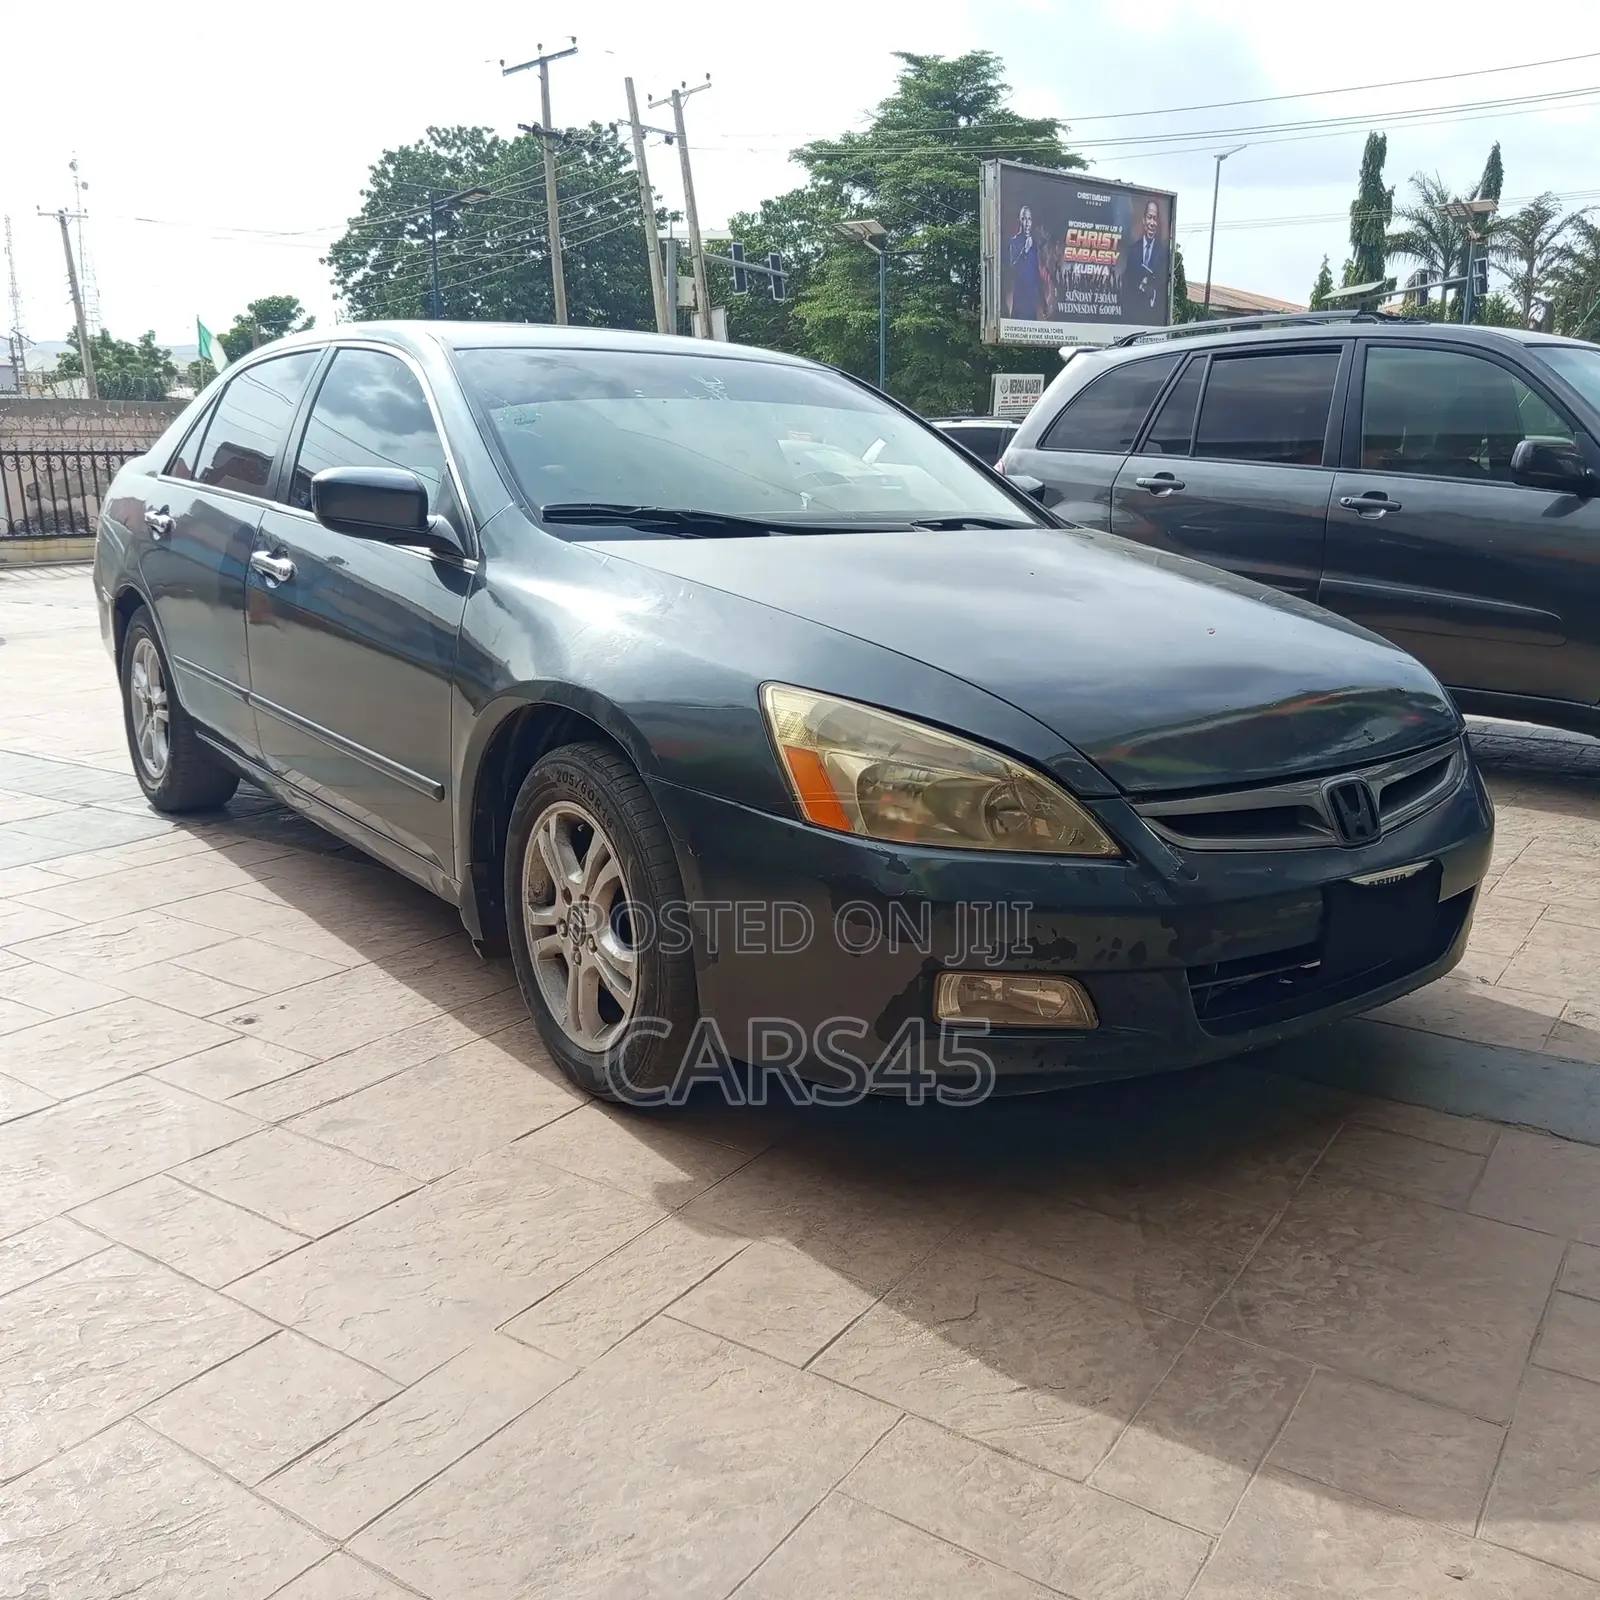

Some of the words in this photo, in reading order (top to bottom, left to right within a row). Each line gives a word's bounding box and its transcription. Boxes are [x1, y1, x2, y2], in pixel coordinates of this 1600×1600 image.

[1068, 220, 1094, 229] WORSHIP
[1095, 223, 1110, 231] WITH
[1065, 228, 1122, 251] CHRIST
[1063, 247, 1120, 265] EMBASSY
[1073, 263, 1110, 276] KUBWA
[1065, 290, 1093, 303] SUNDAY
[1094, 292, 1118, 304] 7:30AM
[1057, 302, 1098, 314] WEDNESDAY
[1099, 305, 1122, 316] 6:00PM
